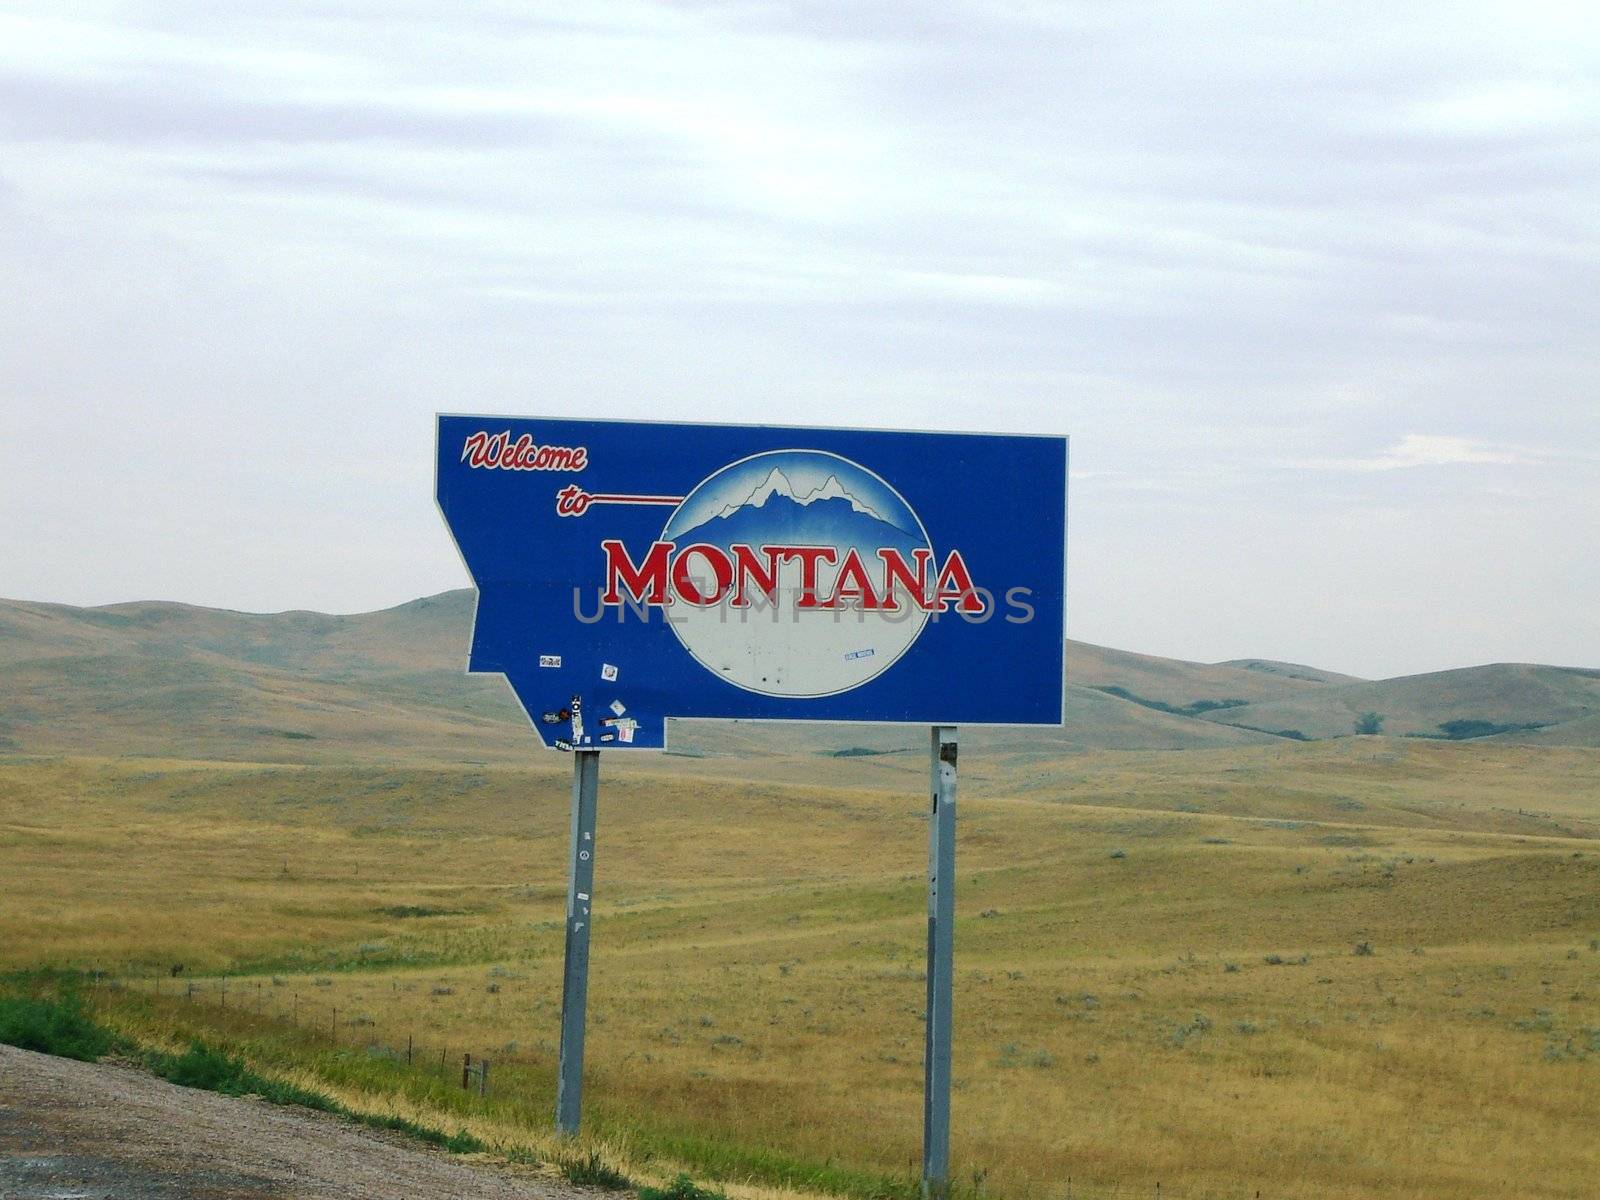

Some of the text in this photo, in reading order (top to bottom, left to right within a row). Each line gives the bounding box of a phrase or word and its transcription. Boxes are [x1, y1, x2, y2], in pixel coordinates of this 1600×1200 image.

[461, 430, 588, 471] Welcome
[556, 484, 592, 517] to
[601, 539, 985, 613] MONTANA
